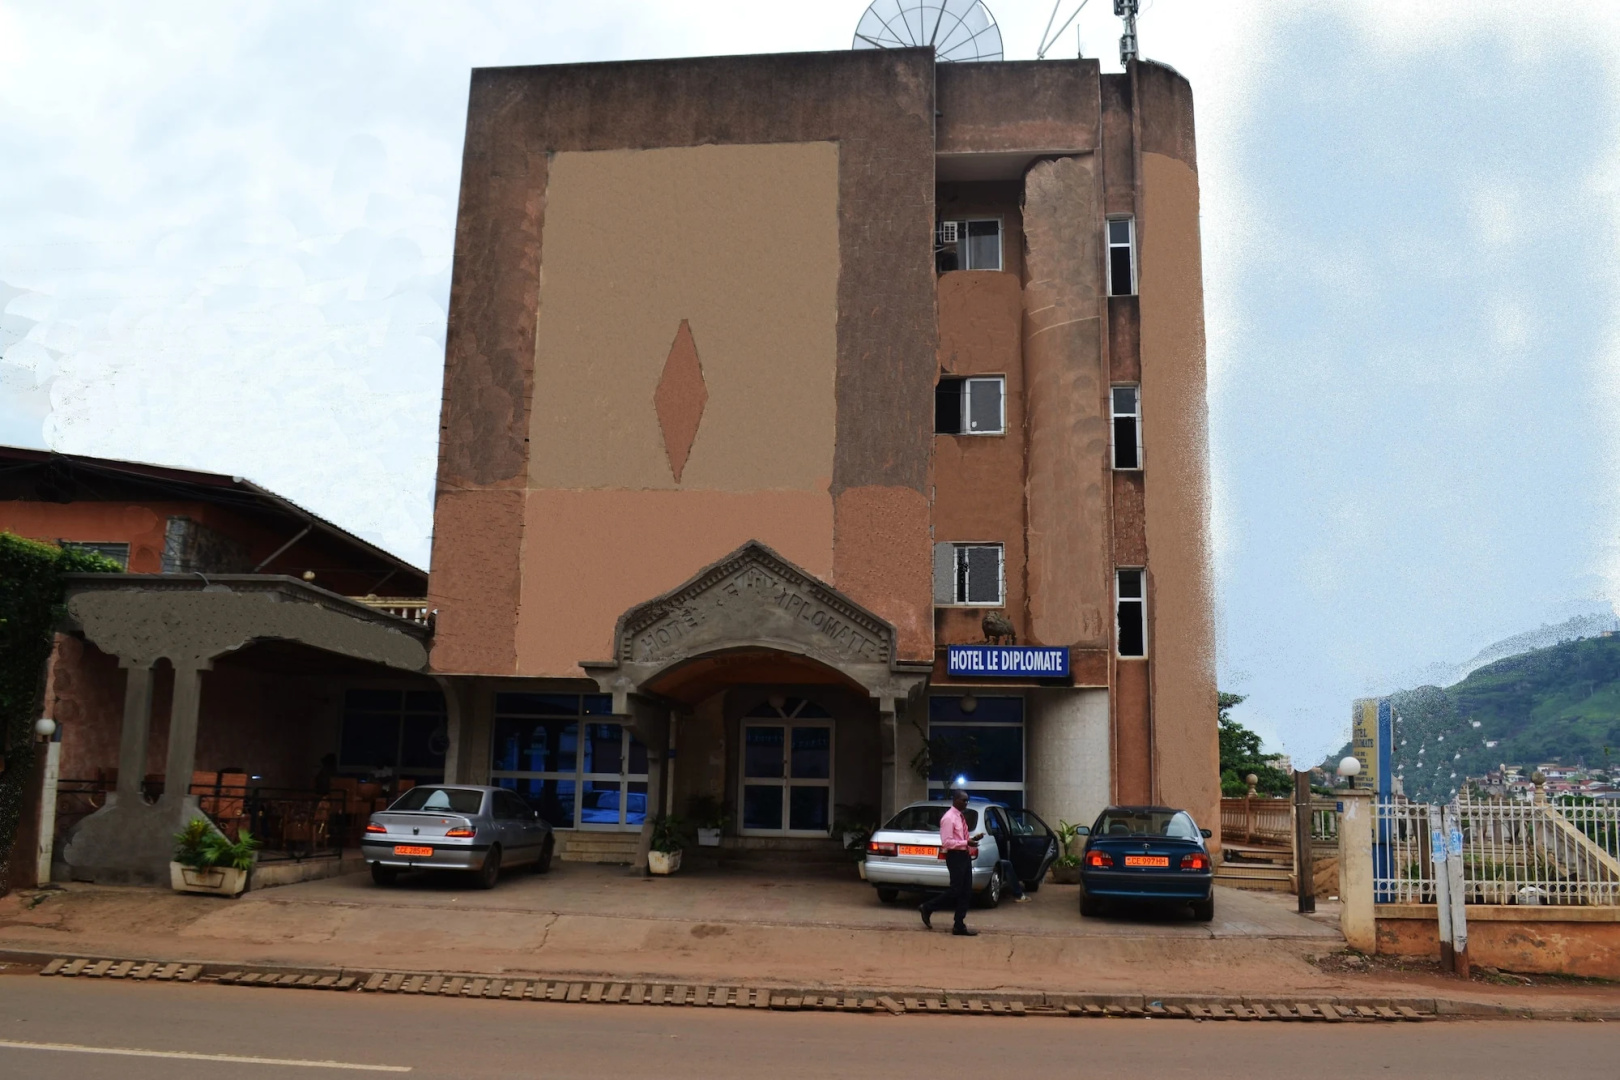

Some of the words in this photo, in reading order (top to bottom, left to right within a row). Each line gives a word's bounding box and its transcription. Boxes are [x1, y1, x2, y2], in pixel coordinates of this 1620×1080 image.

[951, 650, 984, 670] HOTEL
[987, 651, 998, 670] LE
[1002, 651, 1062, 671] DIPLOMATE
[1131, 857, 1141, 865] CE
[1142, 857, 1156, 865] 997
